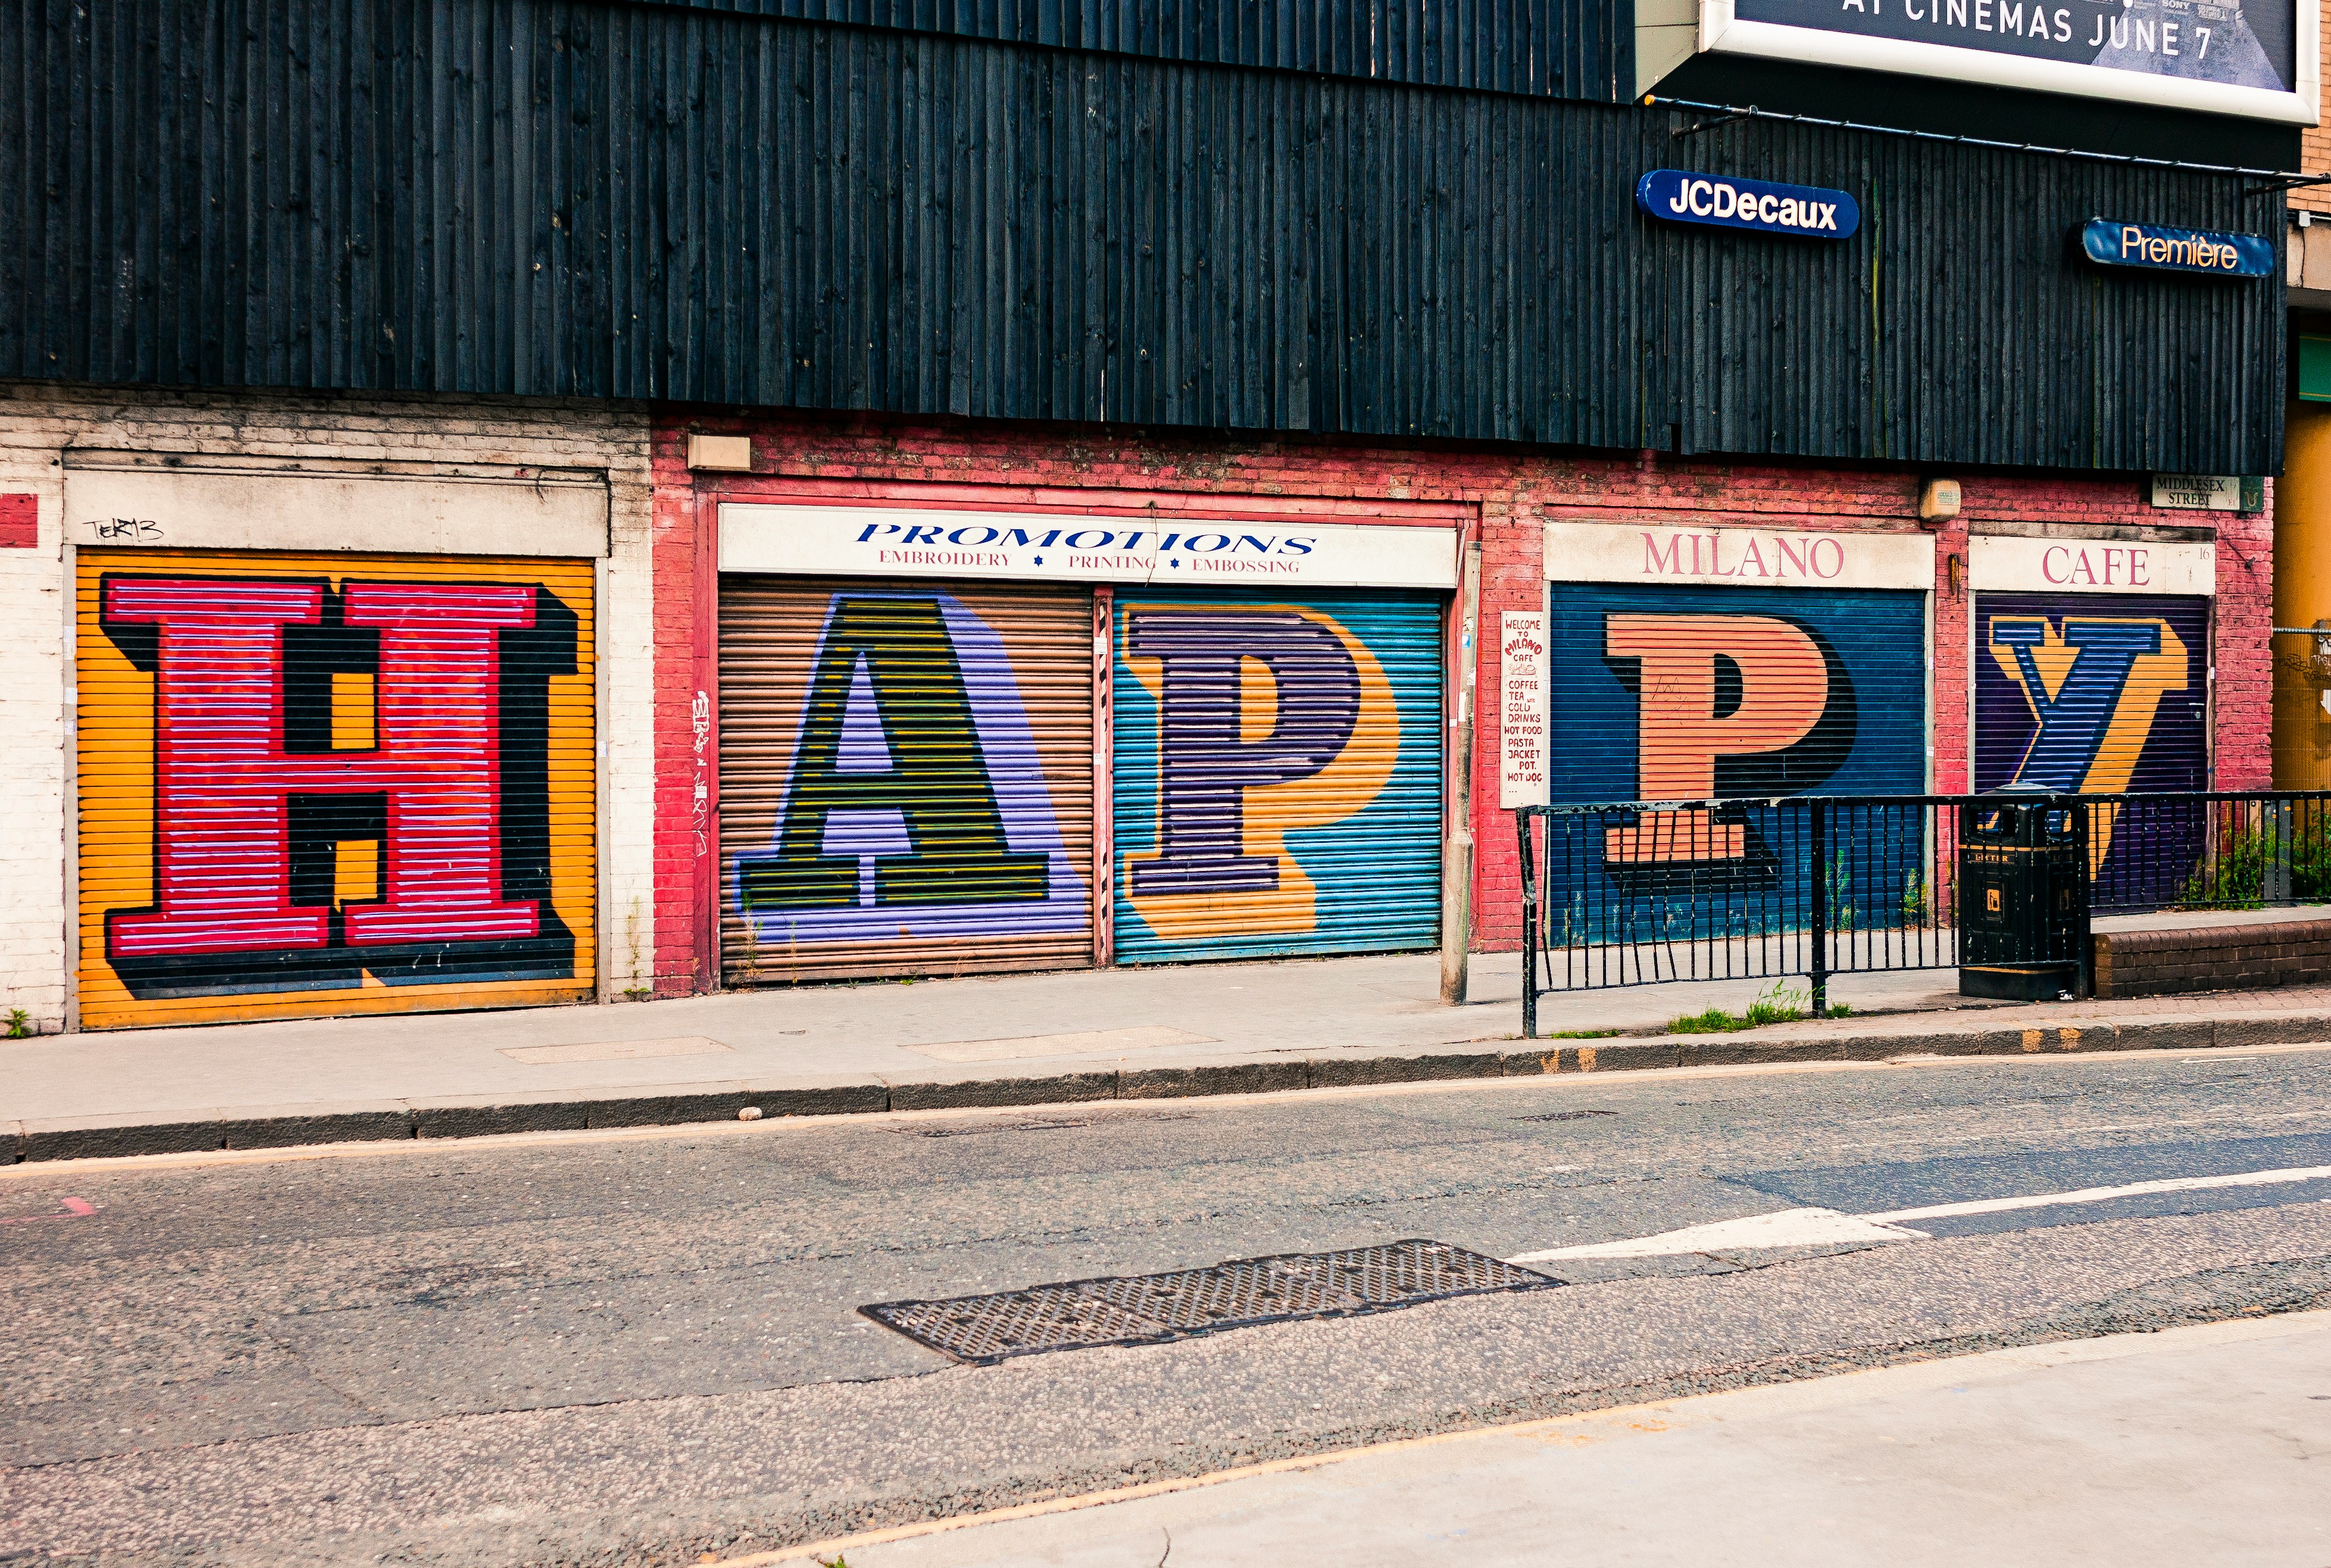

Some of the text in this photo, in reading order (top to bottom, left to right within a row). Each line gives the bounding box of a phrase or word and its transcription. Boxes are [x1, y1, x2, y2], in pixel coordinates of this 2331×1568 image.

[1905, 0, 2211, 60] CINEMAS JUNE 7
[1669, 178, 1837, 230] JCDecaux
[2121, 226, 2238, 269] Première
[2157, 477, 2225, 492] MIDDLESEX
[2168, 492, 2212, 506] STREET
[853, 523, 1317, 555] PROMOTIONS
[1639, 532, 1844, 579] MILANO
[2199, 546, 2210, 560] 16
[880, 549, 1299, 573] EMBROIDERY PRINTING EMBOSSING
[2042, 546, 2150, 585] CAFE
[1505, 619, 1541, 630] WELCOME
[1505, 638, 1542, 655] MILANO
[1509, 680, 1539, 690] COFFEE
[1509, 691, 1524, 701] TEA
[1508, 702, 1530, 712] COLD
[1508, 714, 1541, 723] DRINKS
[1504, 726, 1542, 735] HOT FOOD
[1508, 738, 1534, 748] PASTA
[1508, 749, 1541, 759] JACKET
[1519, 761, 1537, 770] POT.
[1508, 773, 1542, 782] HOT DOG
